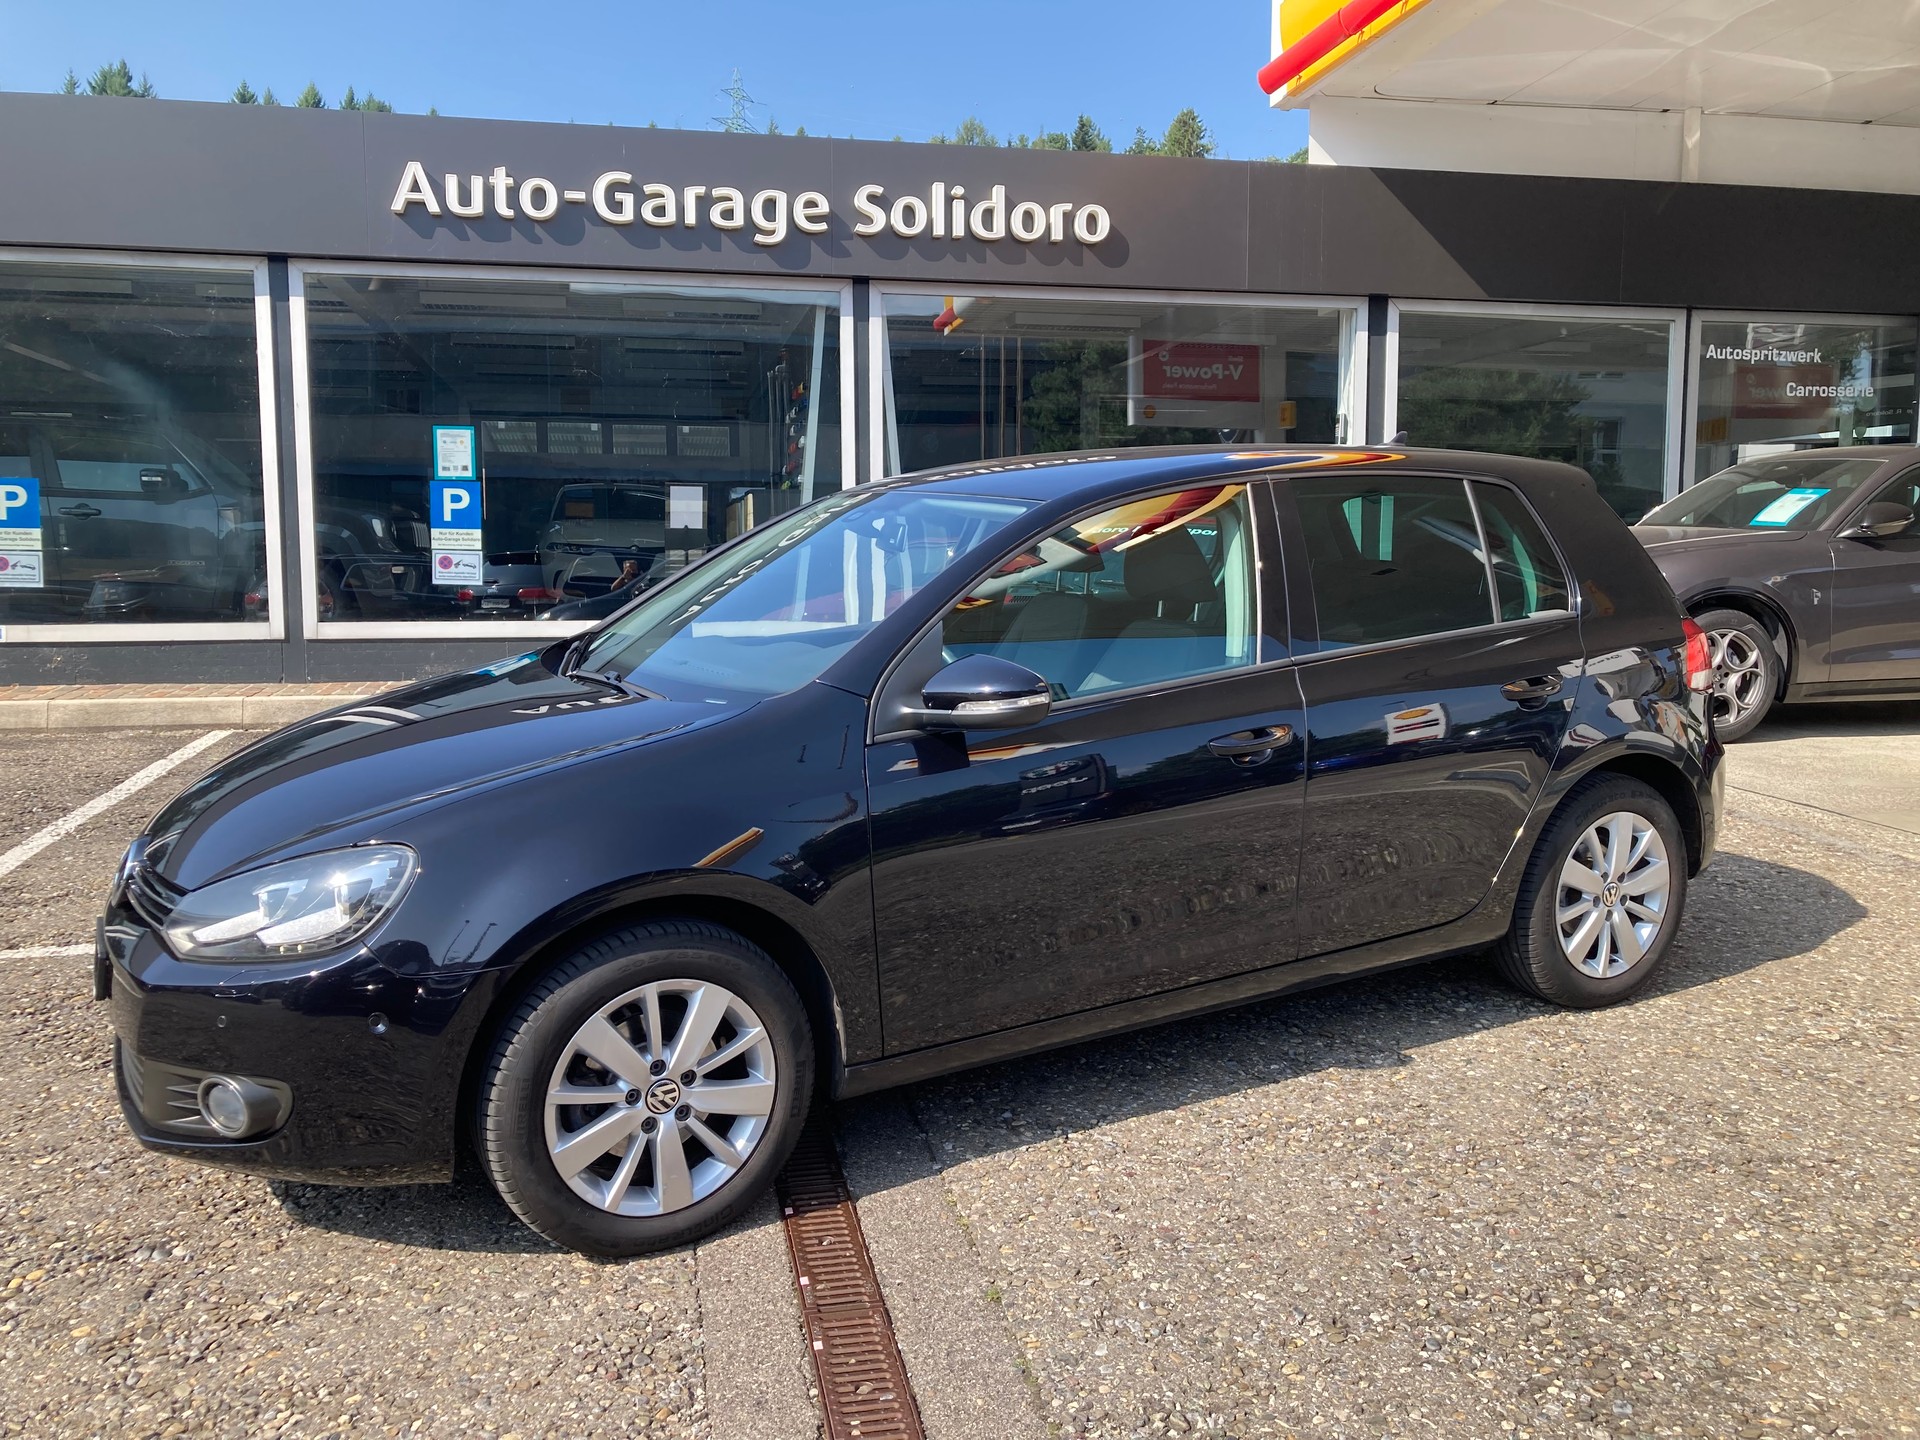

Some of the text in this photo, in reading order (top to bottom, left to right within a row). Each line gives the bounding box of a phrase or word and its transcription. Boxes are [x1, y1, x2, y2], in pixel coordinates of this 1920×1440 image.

[390, 160, 1112, 247] Auto-Garage Solidoro
[1706, 344, 1822, 364] Autospritzwerk
[1786, 382, 1874, 398] Carrosserie
[443, 488, 470, 521] P
